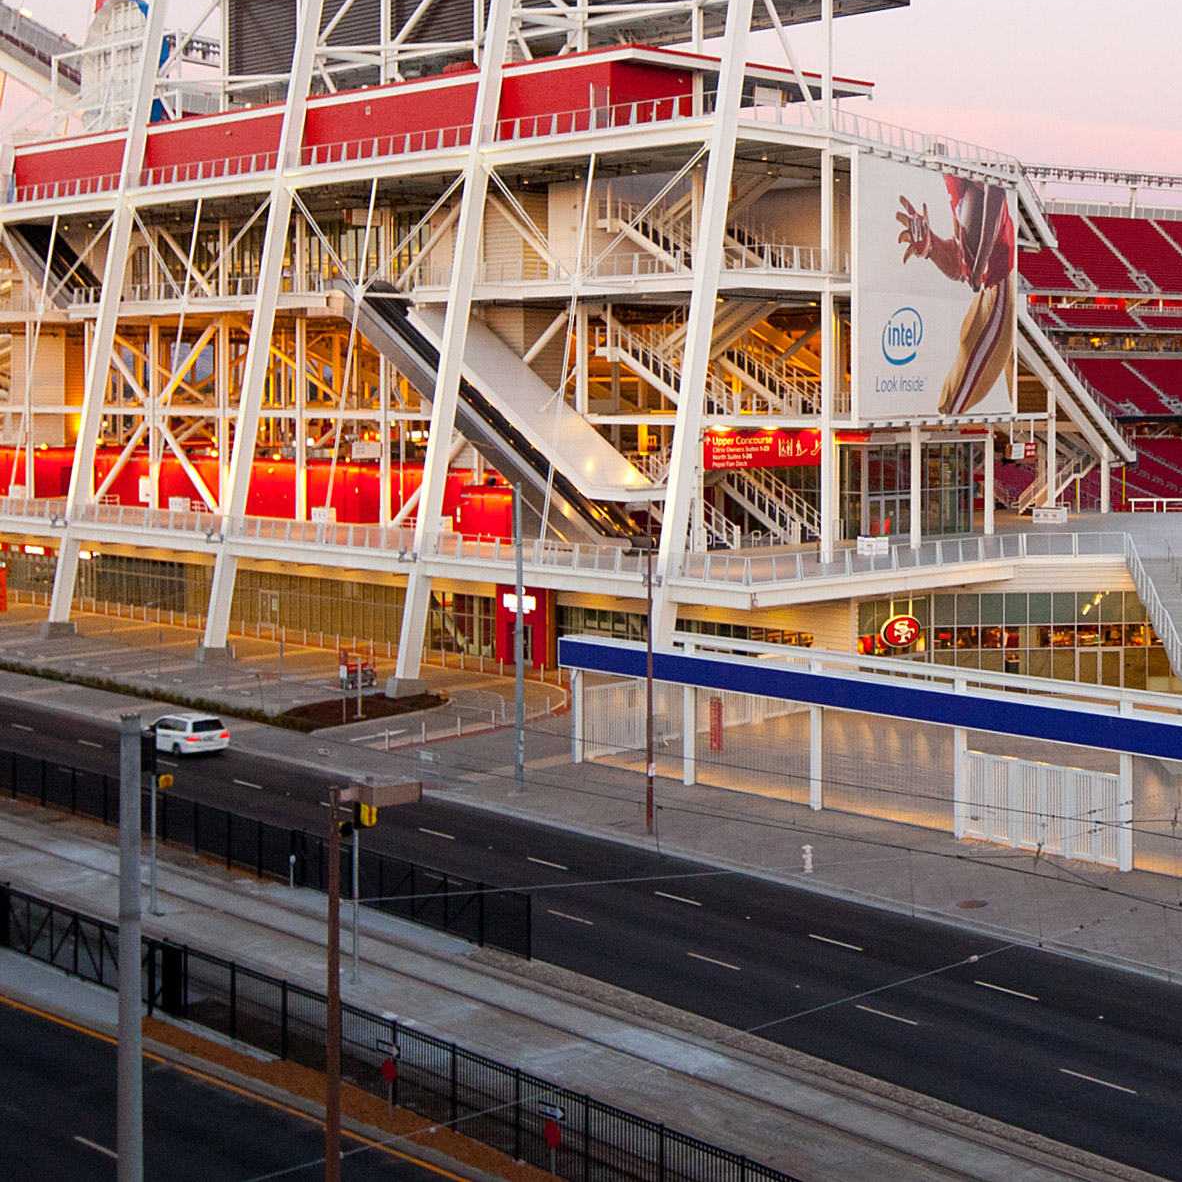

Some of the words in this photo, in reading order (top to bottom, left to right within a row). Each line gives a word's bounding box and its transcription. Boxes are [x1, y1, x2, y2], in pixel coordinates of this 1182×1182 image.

[888, 320, 917, 347] intel
[875, 376, 897, 392] Look
[712, 436, 735, 446] Upper
[736, 436, 773, 445] Concourse
